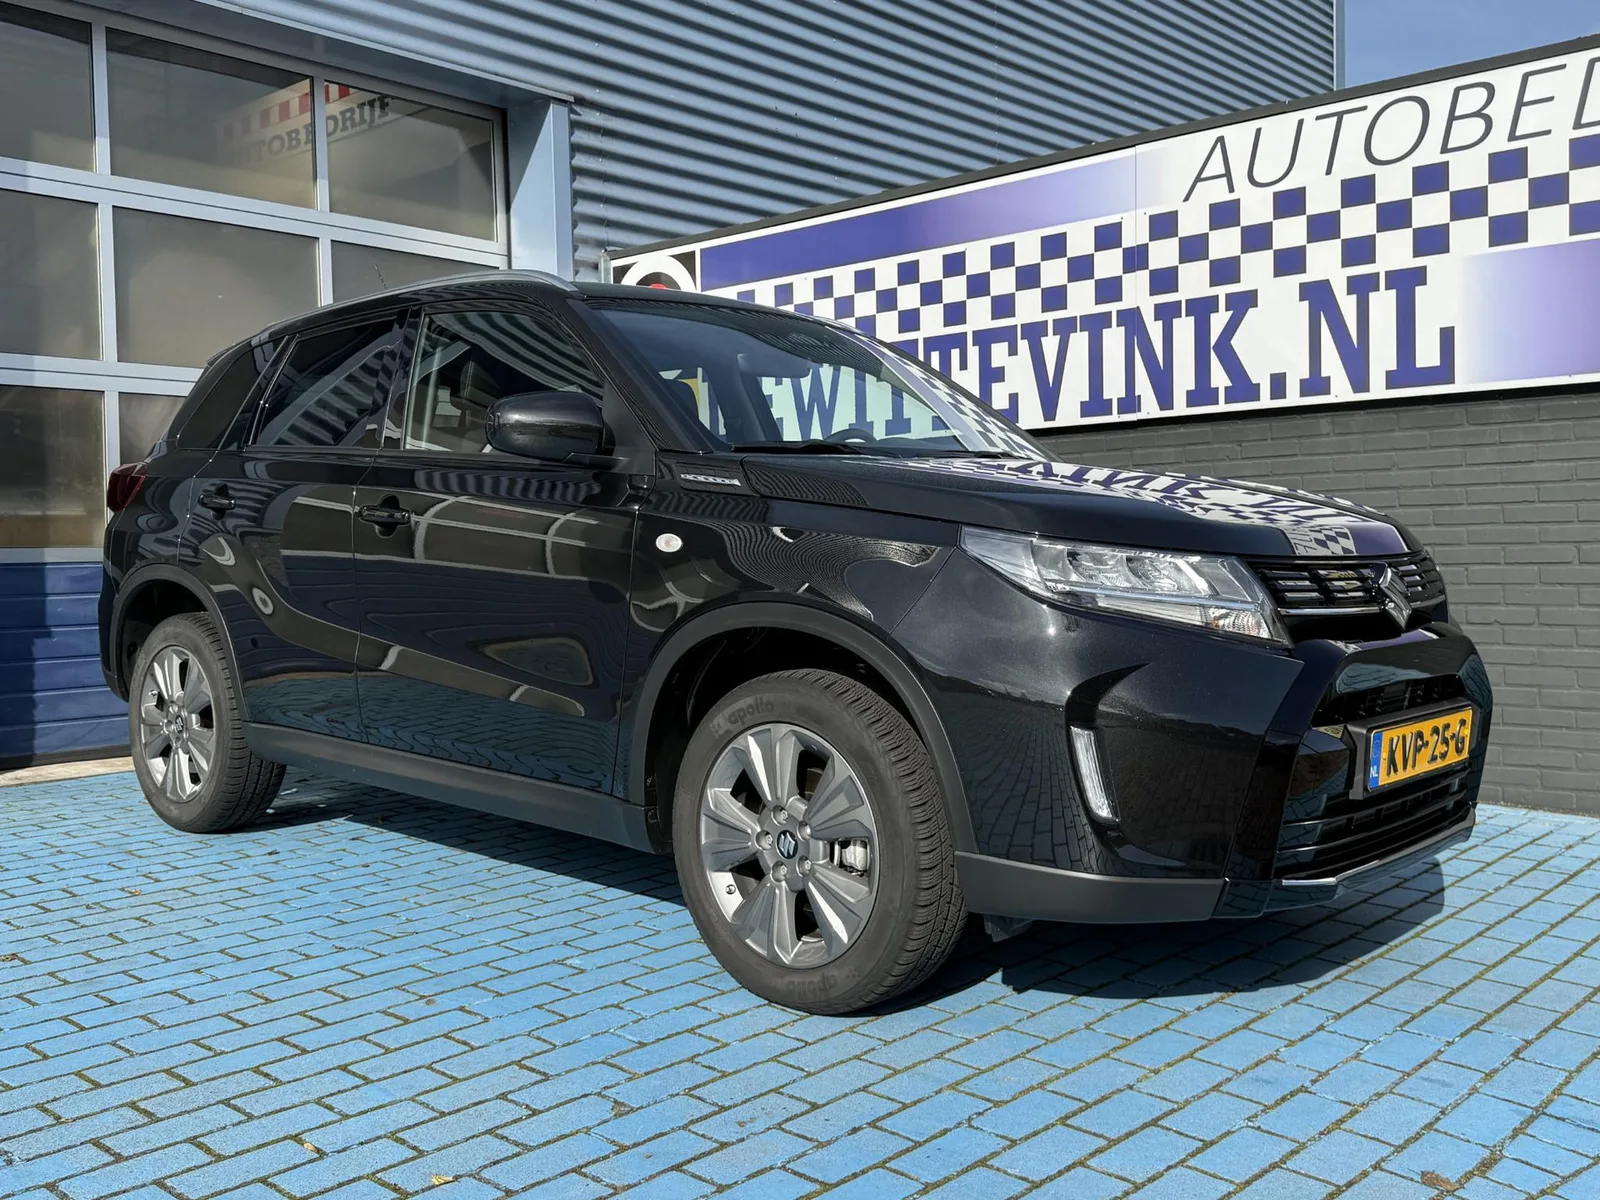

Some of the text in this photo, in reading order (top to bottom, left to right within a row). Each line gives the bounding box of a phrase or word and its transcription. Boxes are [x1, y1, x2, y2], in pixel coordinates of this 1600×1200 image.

[728, 695, 775, 726] apollo
[1386, 717, 1467, 777] KVP-25-G
[1369, 765, 1379, 778] NL
